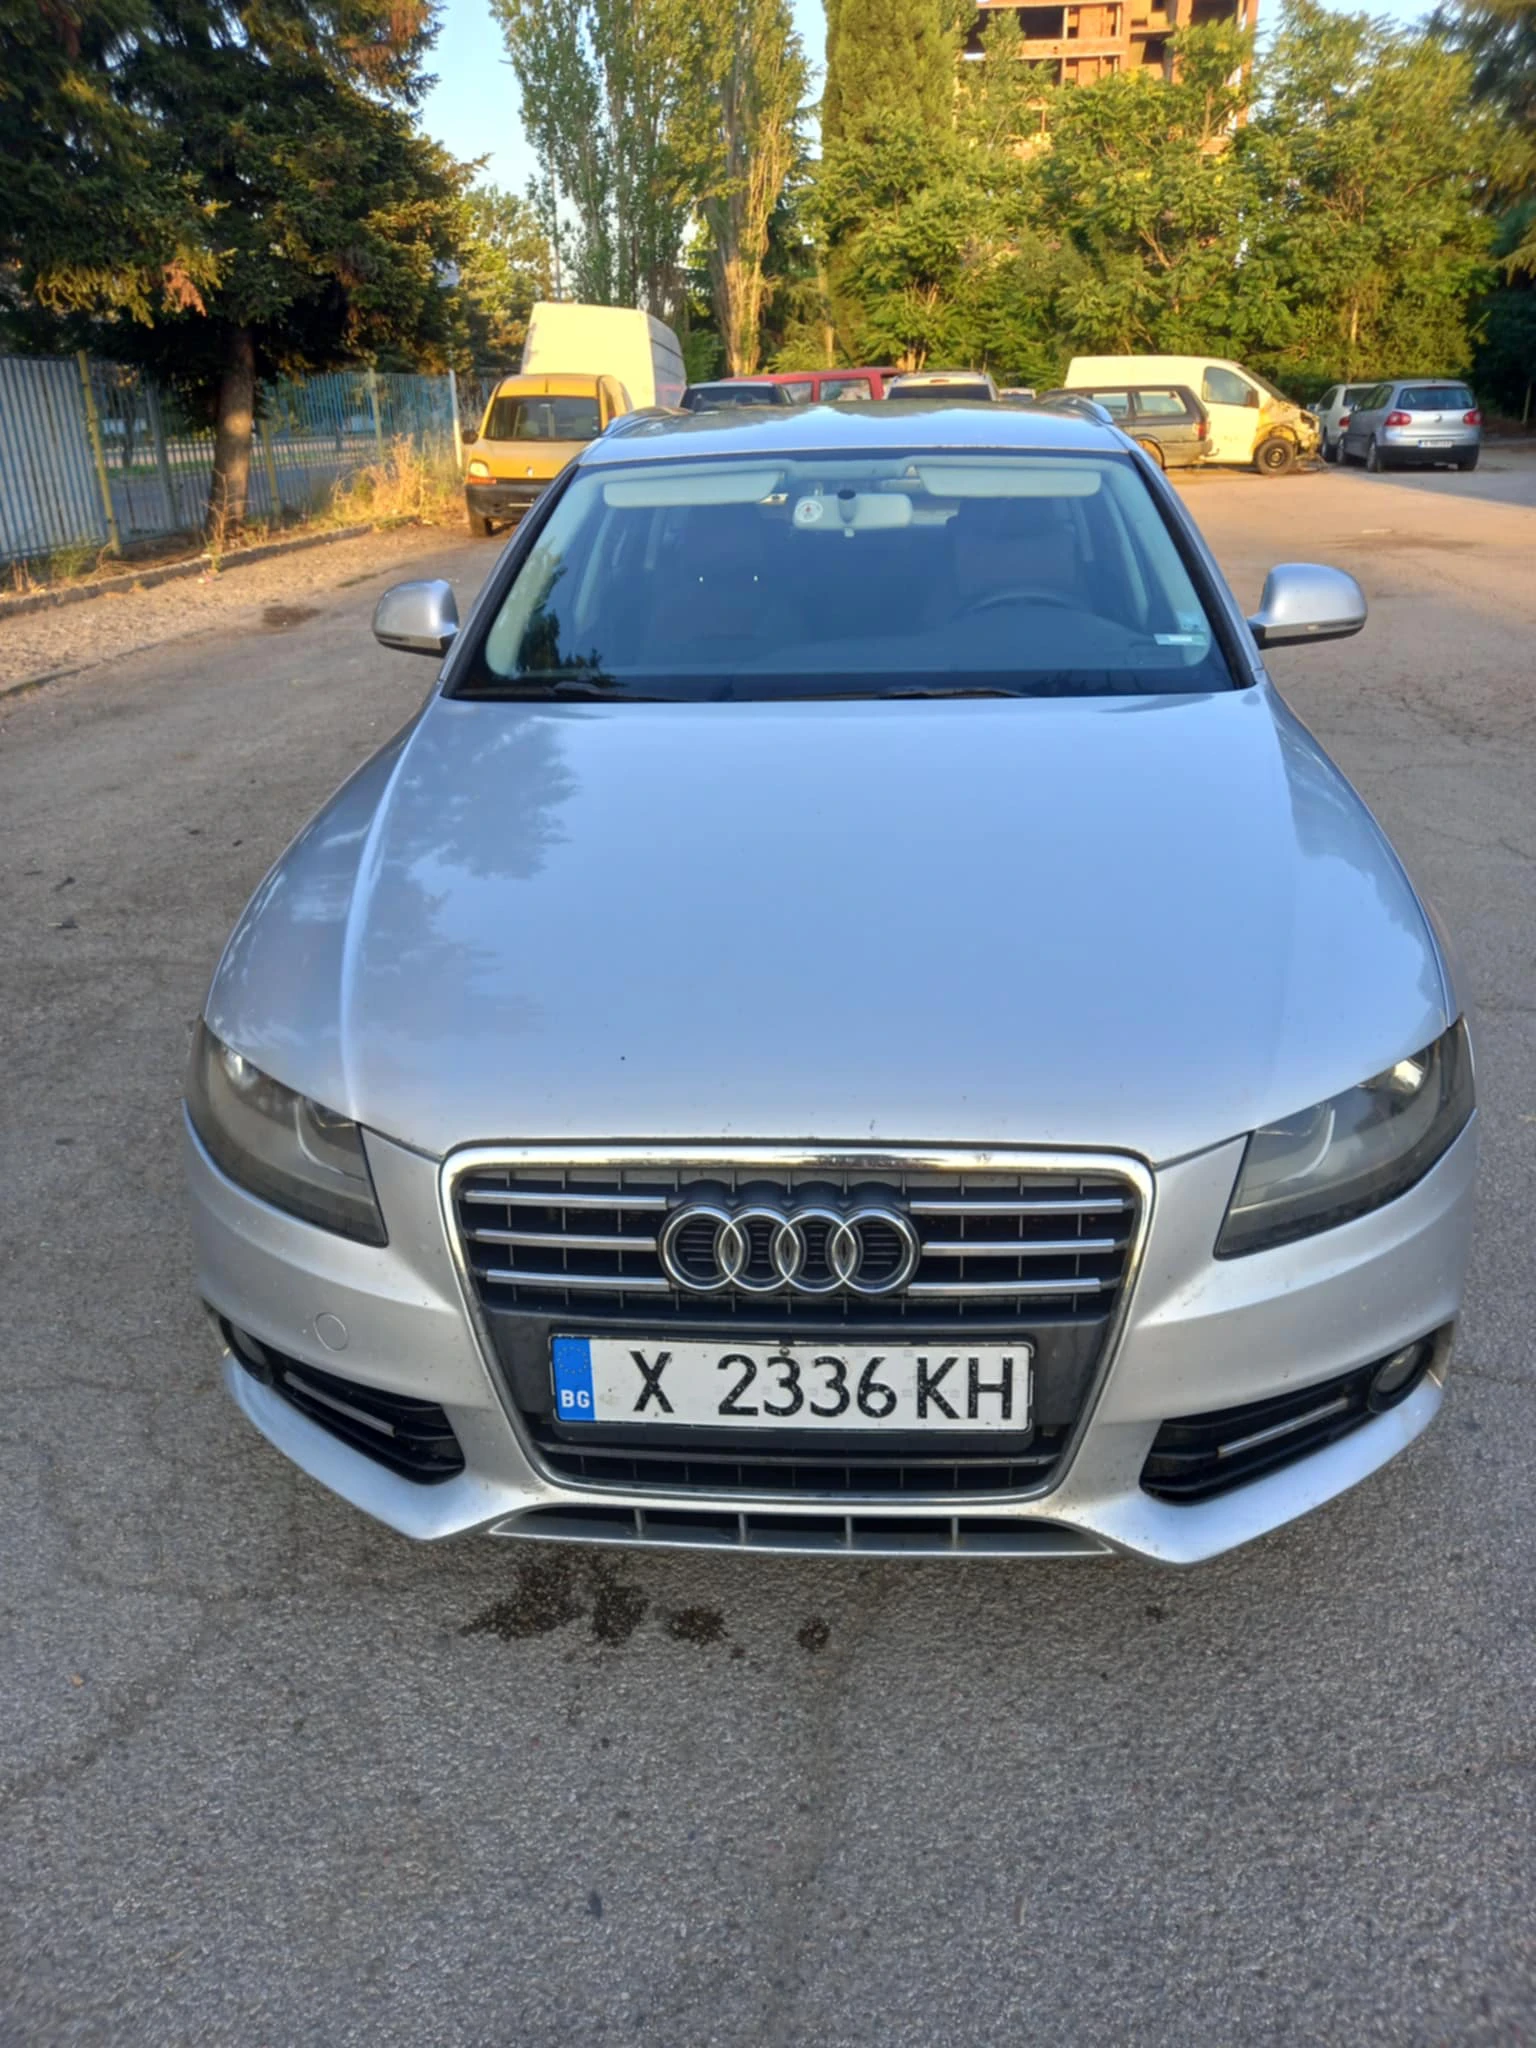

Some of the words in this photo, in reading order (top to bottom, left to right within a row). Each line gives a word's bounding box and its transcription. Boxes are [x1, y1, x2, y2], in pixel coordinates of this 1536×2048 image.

[560, 1389, 591, 1409] BG
[629, 1350, 675, 1414] X
[717, 1353, 898, 1419] 2336
[916, 1356, 1014, 1420] KH
